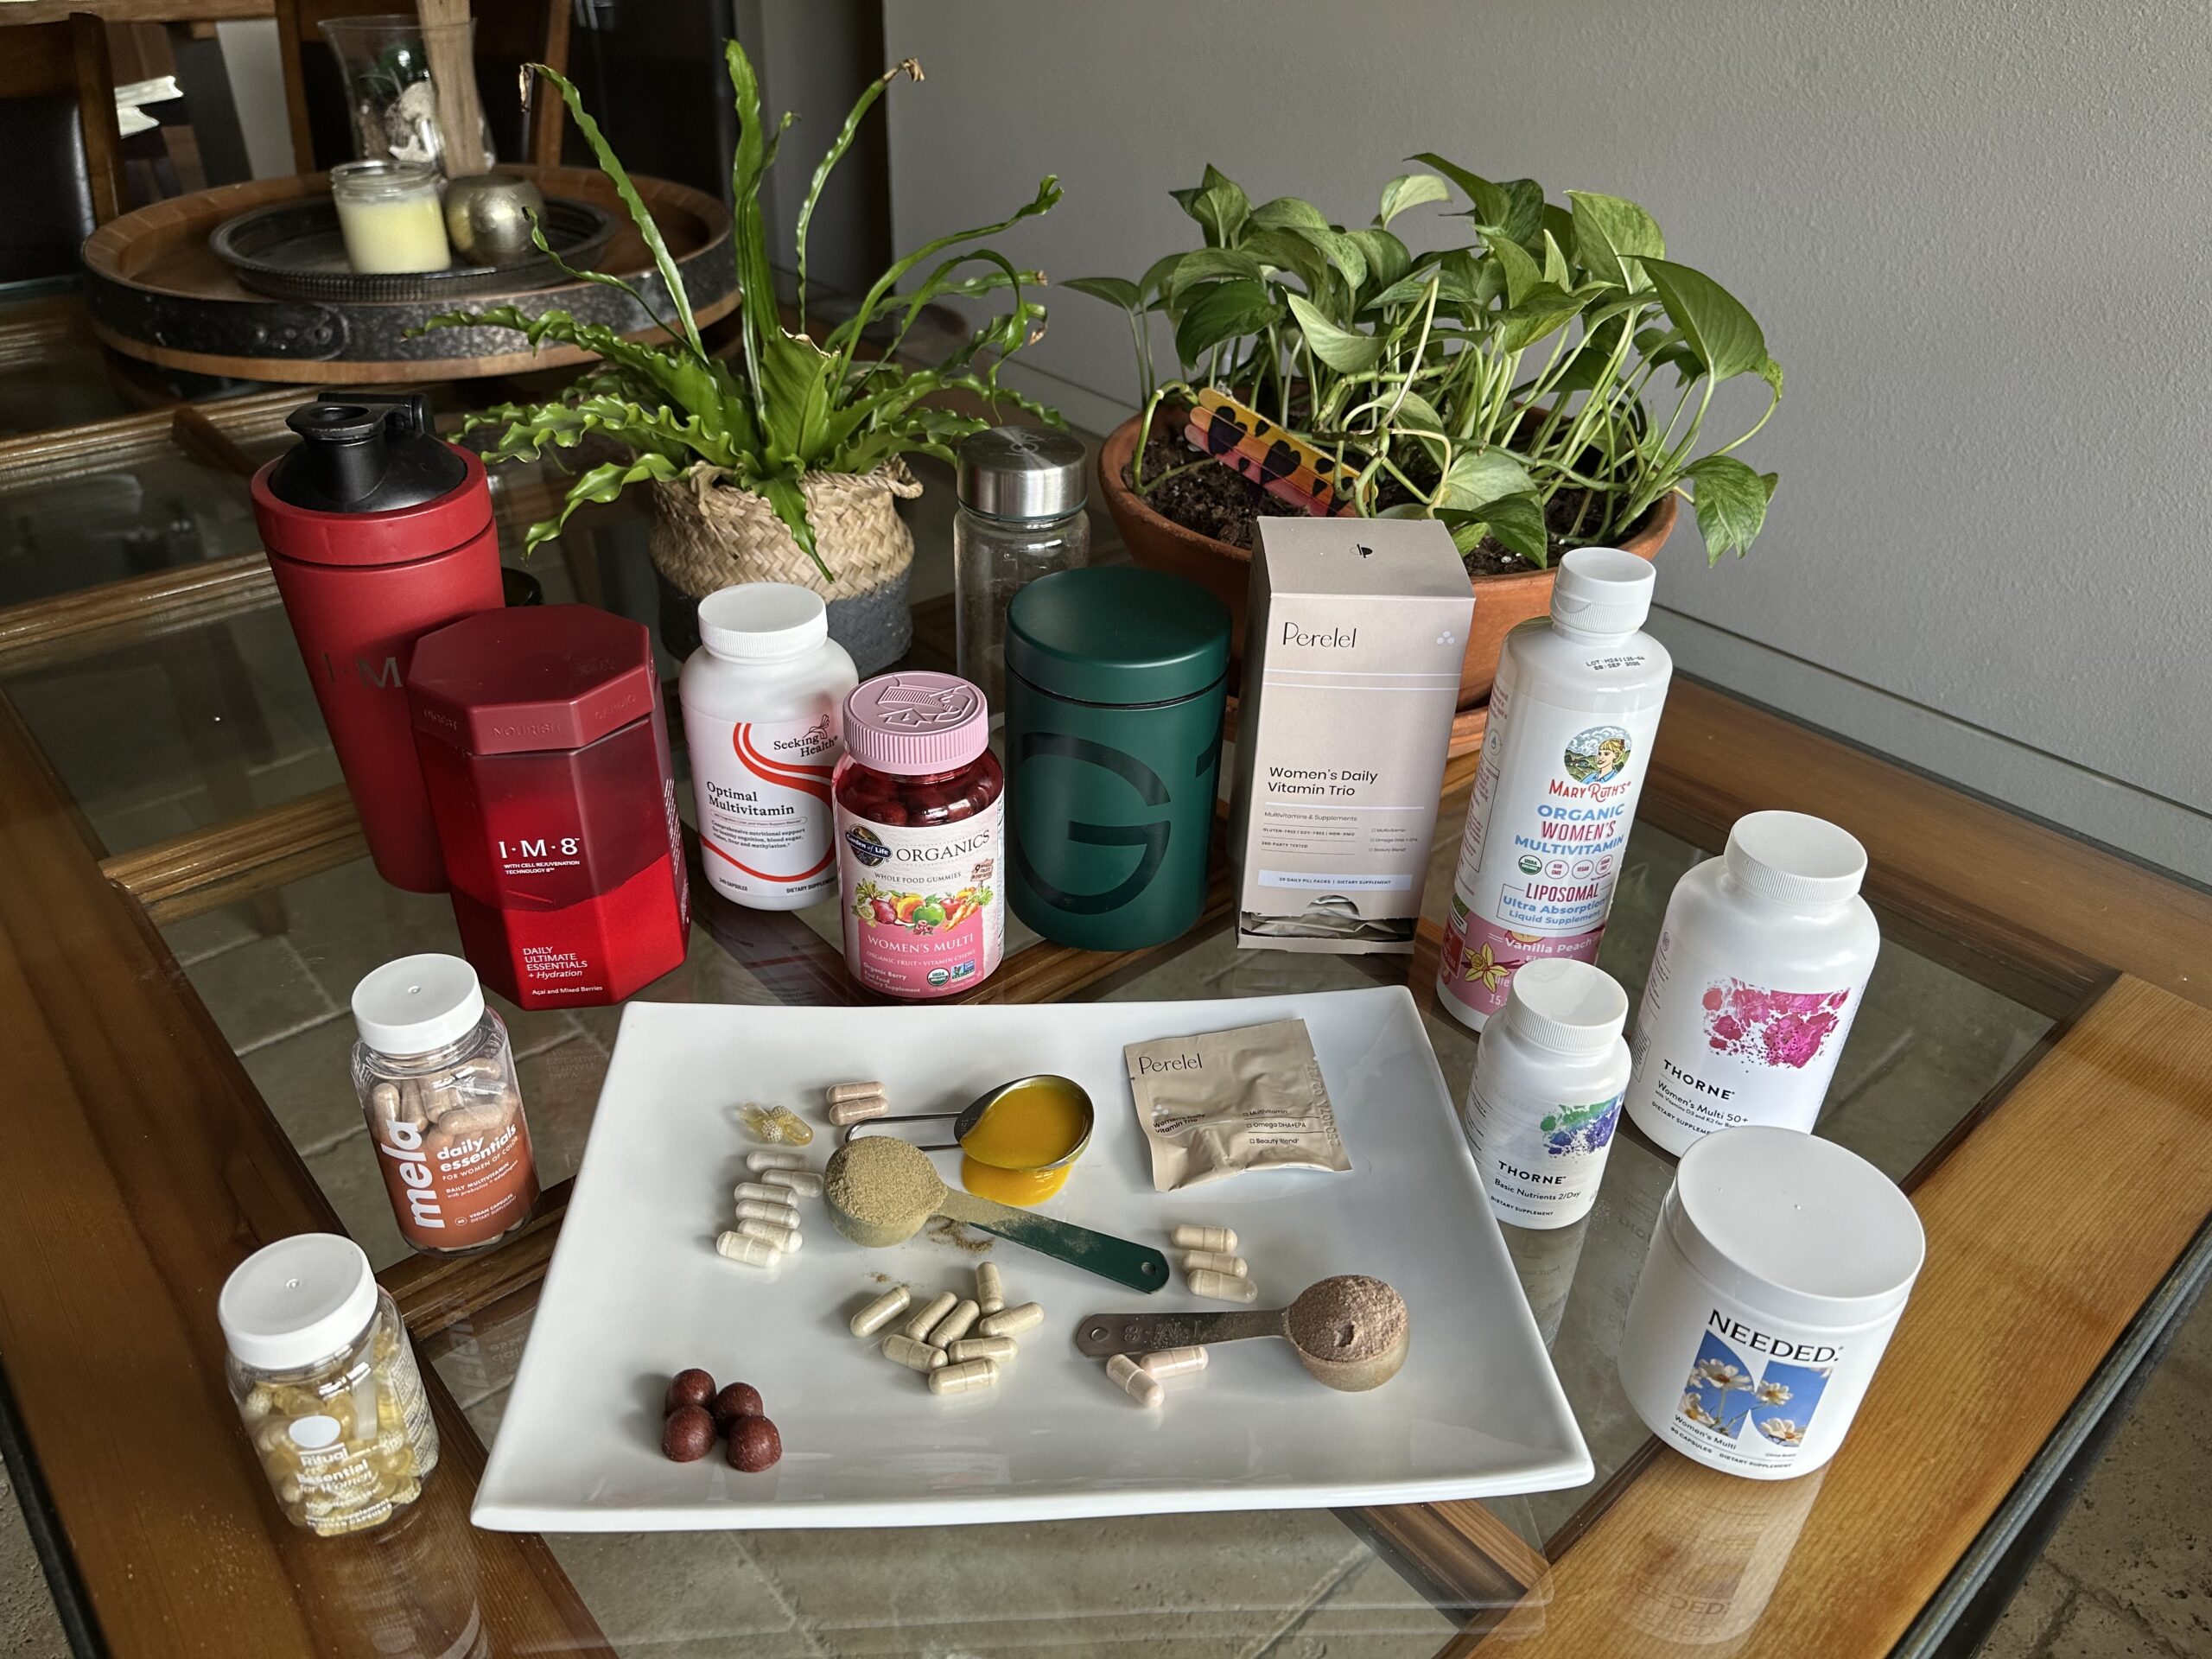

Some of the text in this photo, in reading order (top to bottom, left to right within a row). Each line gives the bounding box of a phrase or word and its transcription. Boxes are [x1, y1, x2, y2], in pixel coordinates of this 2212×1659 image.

[1282, 621, 1357, 649] Perelel
[773, 734, 819, 751] Seeking
[1268, 766, 1378, 785] Women's Daily
[707, 780, 758, 803] Optimal
[1268, 781, 1356, 796] Vitamin Trio
[1548, 779, 1587, 798] MARY
[709, 794, 795, 817] Multivitamin
[1537, 803, 1624, 821] ORGANIC
[1264, 811, 1307, 820] Multivitamins
[1314, 814, 1357, 823] Supplements
[711, 819, 748, 836] Comprehensive
[781, 828, 806, 837] support
[1541, 820, 1617, 842] WOMEN'S
[846, 833, 889, 855] Garden of Life
[896, 830, 990, 862] ORGANICS
[1515, 834, 1624, 855] MULTIVITAMIN
[727, 880, 748, 892] CAPSULES
[874, 872, 900, 883] WHOLE
[926, 872, 962, 883] GUMMIES
[1525, 882, 1599, 903] LIPOSOMAL
[1503, 895, 1536, 912] Ultra
[1509, 910, 1601, 925] Liquid Supplement
[523, 946, 553, 956] DAILY
[868, 933, 974, 953] WOMEN'S MULTI
[1505, 937, 1592, 954] Vanilla Peach
[524, 952, 577, 963] ULTIMATE
[526, 960, 588, 971] ESSENTIALS
[867, 950, 895, 964] ORGANIC
[923, 957, 953, 967] VITAMIN
[954, 950, 976, 962] CHEWS
[537, 969, 582, 980] Hydration
[863, 962, 907, 981] Organic Berry
[876, 975, 890, 984] Food
[884, 982, 920, 993] Supplement
[1139, 1052, 1203, 1075] Perelel
[1663, 1058, 1732, 1100] THORNE
[1651, 1101, 1675, 1120] DIETARY
[1658, 1080, 1749, 1123] Women's Multi 50+
[1664, 1096, 1685, 1112] Vitamins
[1153, 1116, 1185, 1128] Women's
[1154, 1121, 1183, 1134] Vitamin
[436, 1136, 485, 1160] daily
[440, 1123, 517, 1173] essentials
[460, 1160, 491, 1177] WOMEN
[492, 1153, 500, 1162] OF
[502, 1135, 518, 1154] COLOR
[380, 1119, 446, 1229] mela
[446, 1161, 510, 1193] DAILY MULTIVITAMIN
[1498, 1160, 1564, 1185] THORNE
[1494, 1178, 1515, 1193] Basic
[1516, 1188, 1556, 1200] Nutrients
[1558, 1191, 1581, 1200] 2/Day
[469, 1193, 513, 1219] VEGAN CAPSULES
[1491, 1195, 1554, 1216] DIETARY SUPPLEMENT
[1675, 1414, 1737, 1450] Women's Multi
[1679, 1433, 1713, 1453] CAPSULES
[300, 1447, 349, 1467] Ritual
[1719, 1452, 1793, 1469] DIETARY SUPPLEMENT
[296, 1459, 369, 1484] Essential
[321, 1471, 373, 1494] Women
